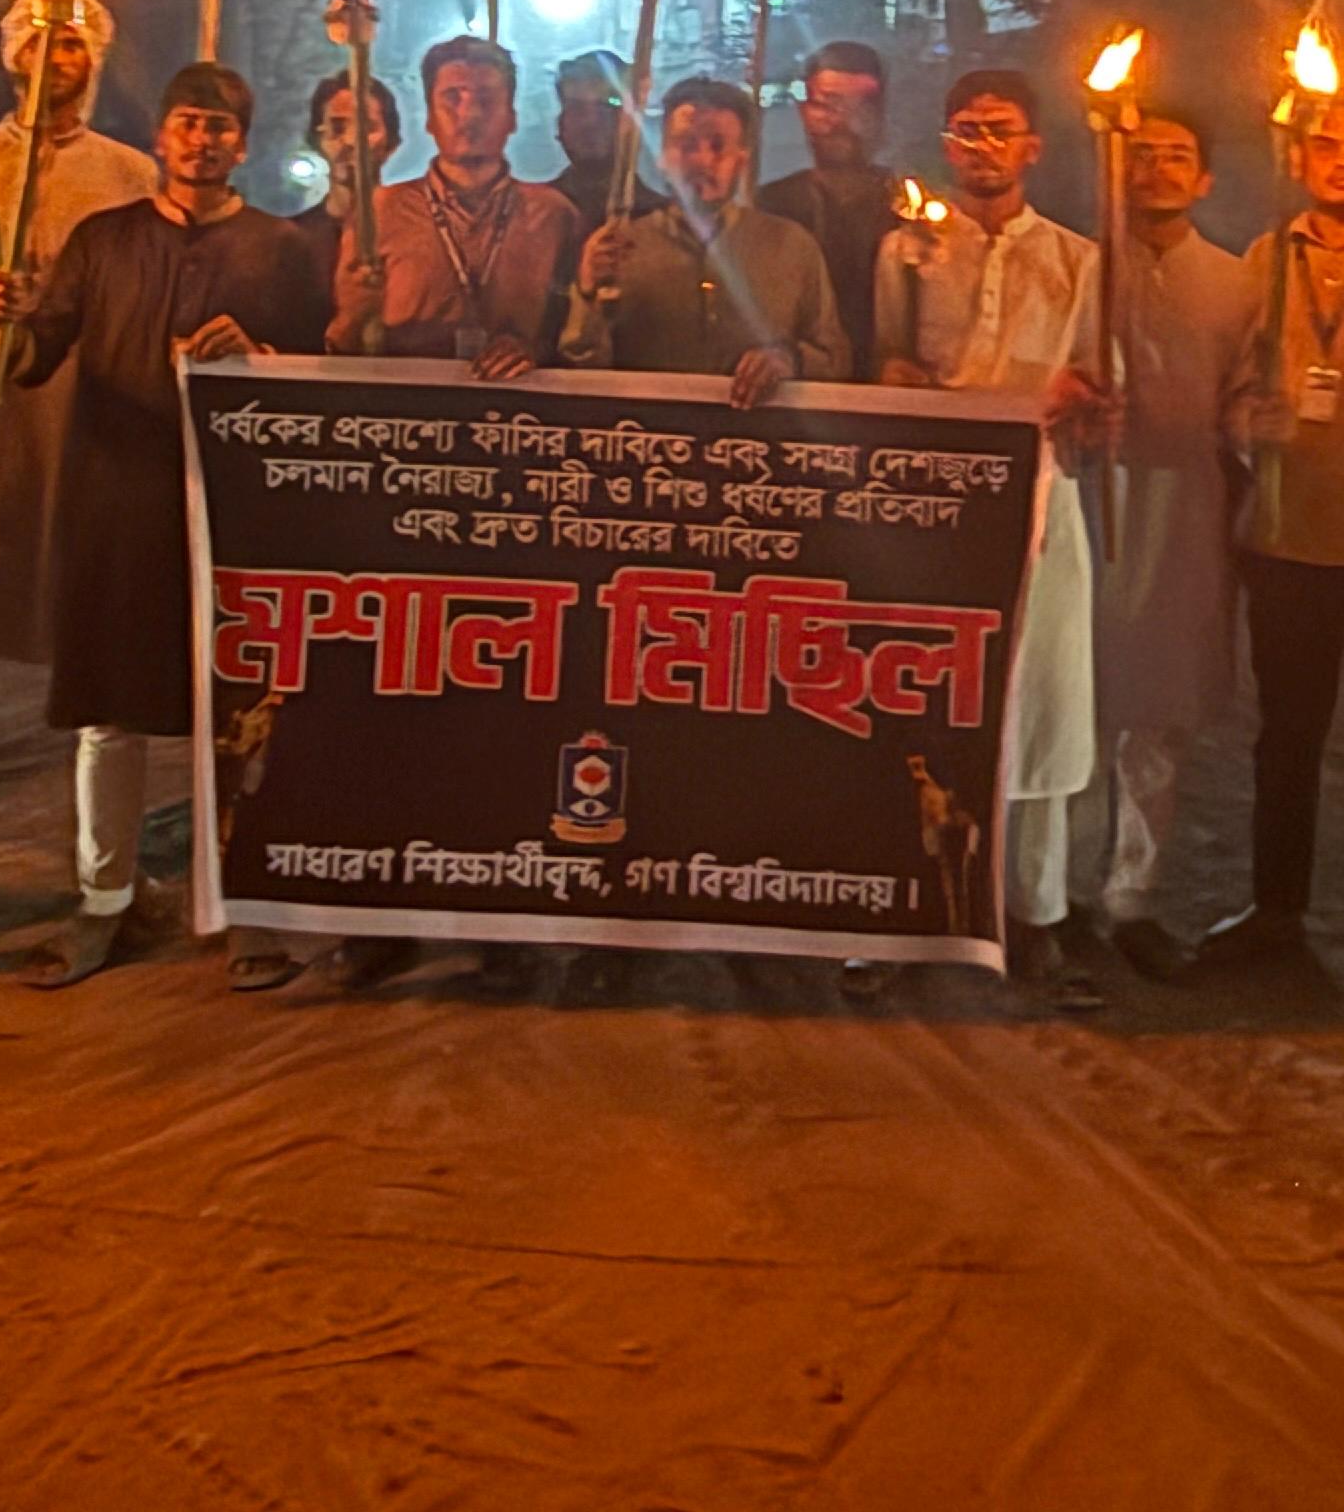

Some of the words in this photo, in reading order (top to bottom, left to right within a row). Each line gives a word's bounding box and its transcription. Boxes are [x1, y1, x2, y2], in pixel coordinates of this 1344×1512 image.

[209, 400, 324, 445] ধর্ষকের
[332, 413, 459, 452] প্রকাশ্যে
[469, 410, 570, 456] ফাঁসির
[579, 420, 696, 465] দাবিতে
[704, 437, 768, 472] এবং
[781, 441, 860, 477] সমগ্র
[869, 447, 1012, 494] দেশজুড়ে
[262, 458, 374, 492] চলমান
[524, 459, 596, 504] নারী
[605, 476, 632, 505] ও
[642, 466, 707, 511] শিশু
[722, 470, 826, 520] ধর্ষণের
[834, 481, 965, 528] প্রতিবাদ
[393, 508, 461, 545] এবং
[469, 512, 542, 549] দ্রুত
[551, 504, 677, 553] বিচারের
[686, 516, 803, 561] দাবিতে
[212, 567, 579, 702] মশাল
[597, 566, 1002, 739] মিছিল
[266, 844, 396, 882] সাধারণ
[625, 857, 681, 894] গণ
